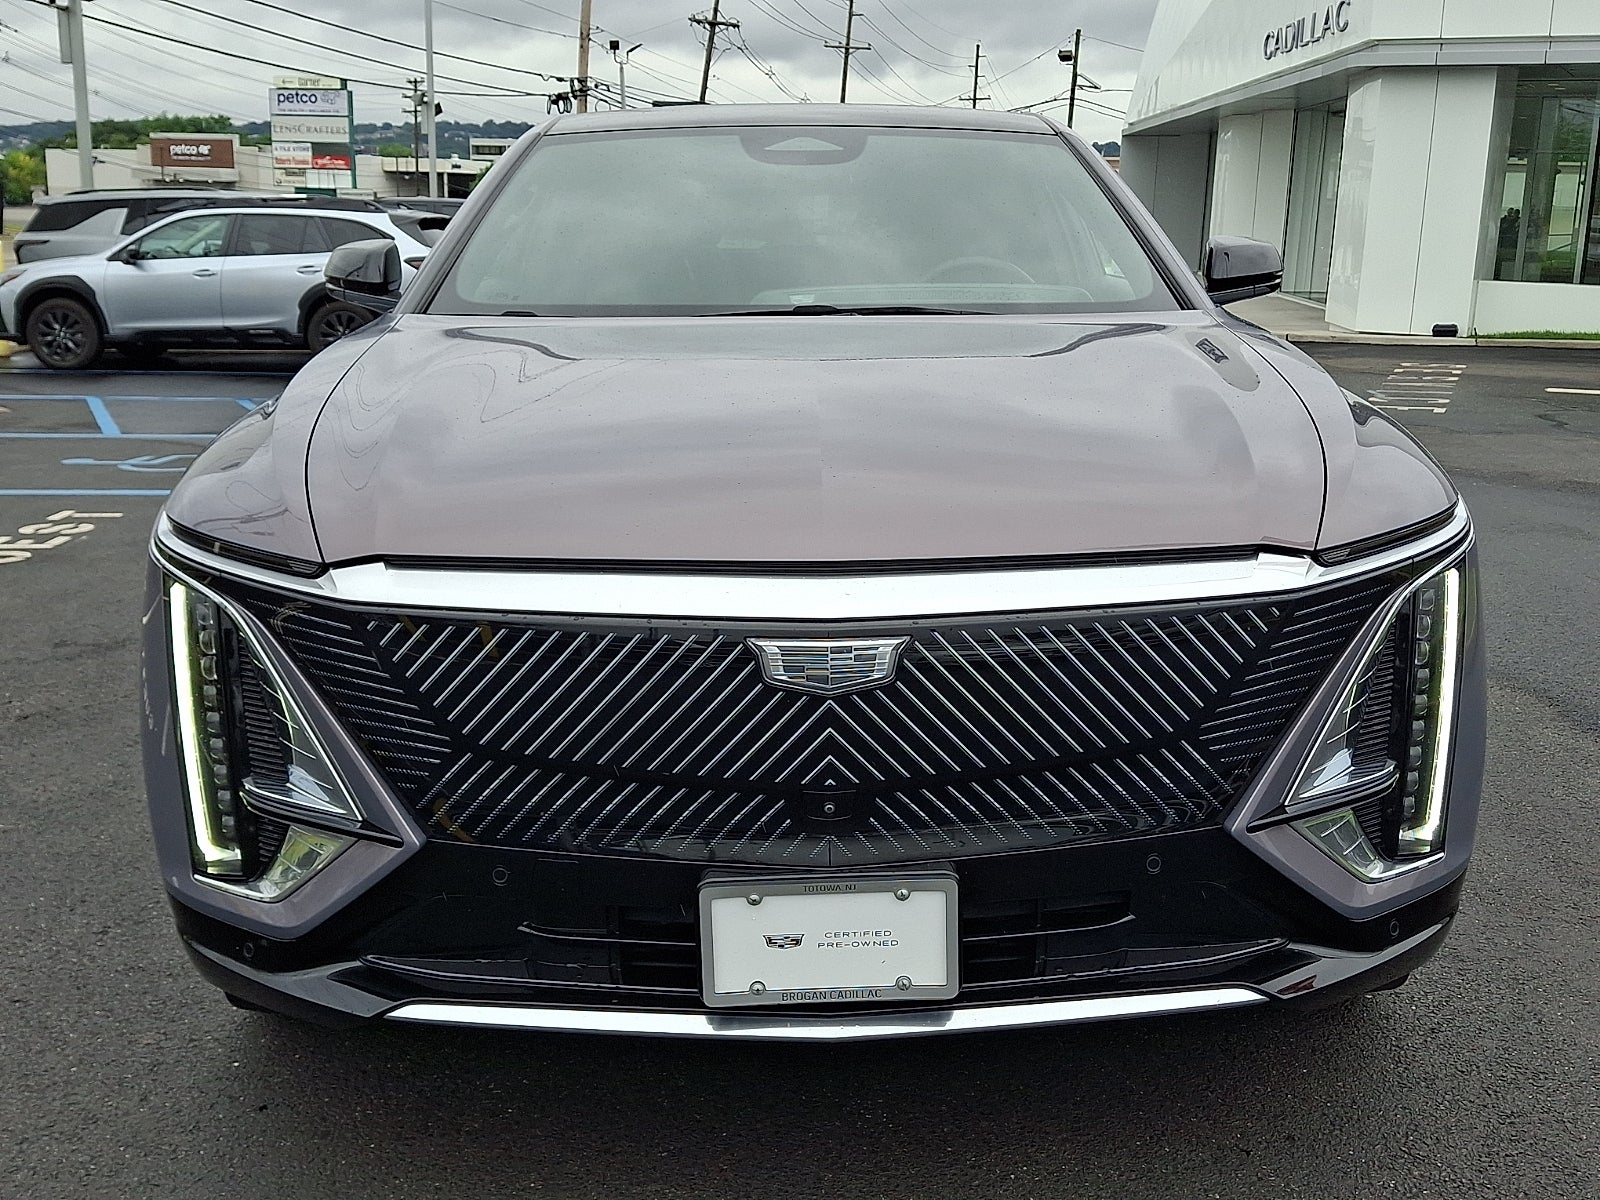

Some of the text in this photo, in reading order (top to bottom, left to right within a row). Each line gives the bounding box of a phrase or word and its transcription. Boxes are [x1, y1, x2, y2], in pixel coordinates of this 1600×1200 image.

[1263, 0, 1351, 61] CADILLAC
[277, 91, 318, 106] petco
[170, 144, 198, 156] petco
[824, 930, 892, 939] CERTIFIED
[817, 940, 899, 949] PRE-OWNED
[781, 989, 882, 1002] BROGAN CADILLAC
